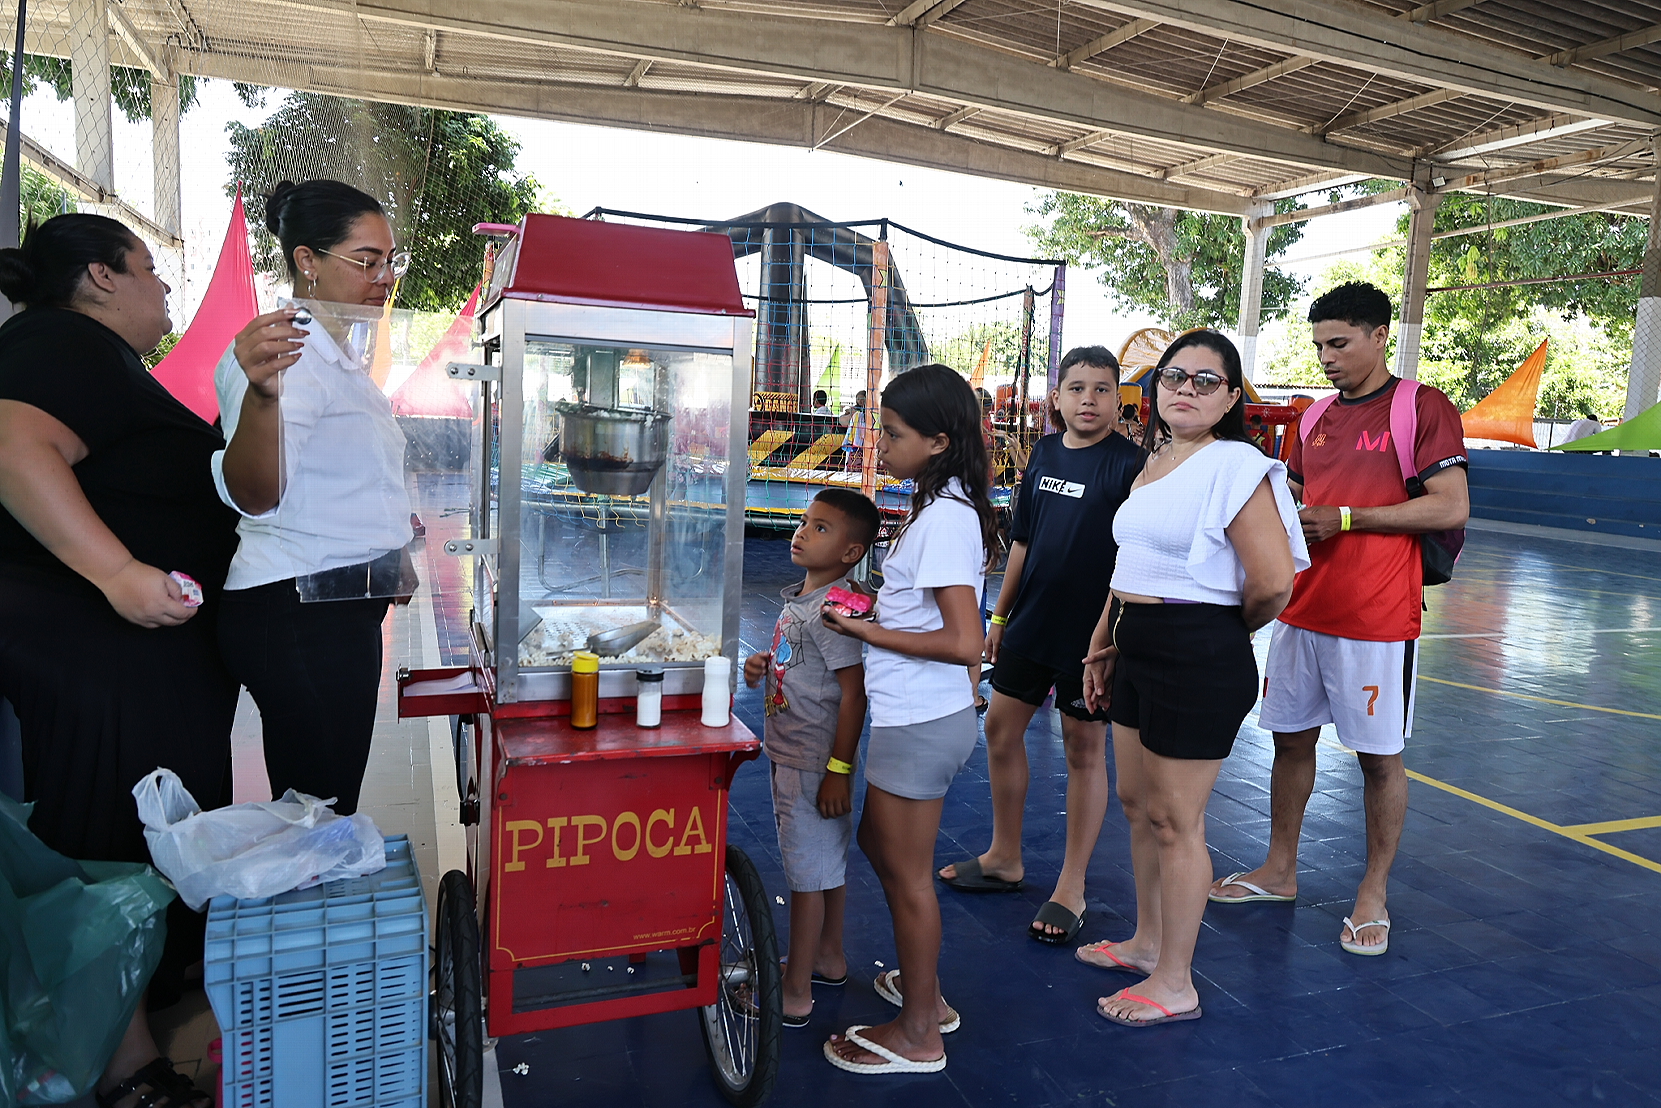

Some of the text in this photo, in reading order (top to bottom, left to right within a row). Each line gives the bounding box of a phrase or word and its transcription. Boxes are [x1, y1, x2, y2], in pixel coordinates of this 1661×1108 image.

[1356, 430, 1390, 452] M
[1041, 479, 1066, 493] NIKE
[1362, 685, 1379, 716] 7
[504, 806, 712, 872] PIPOCA
[633, 927, 696, 940] www.warm.com.br
